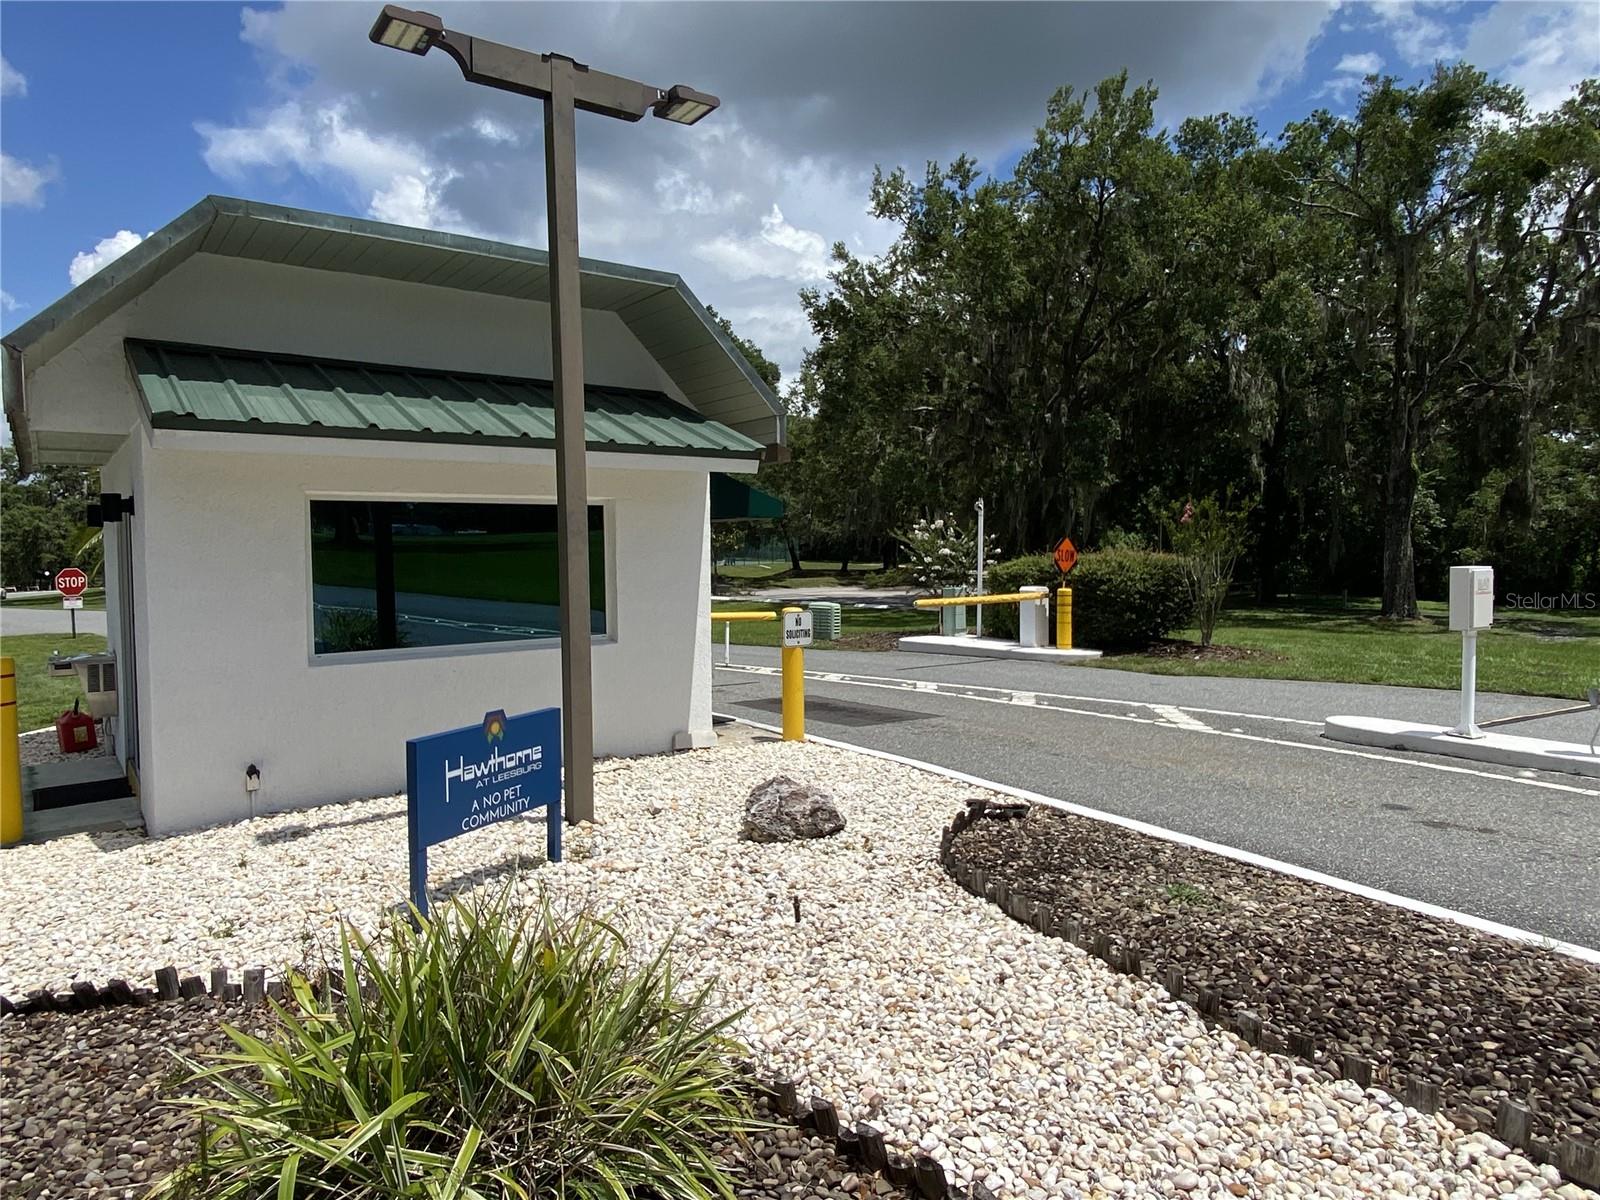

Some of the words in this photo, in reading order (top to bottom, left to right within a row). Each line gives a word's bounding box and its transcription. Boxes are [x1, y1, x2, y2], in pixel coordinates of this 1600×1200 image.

[1055, 549, 1075, 562] SLOW
[58, 576, 85, 589] STOP
[794, 616, 802, 627] NO
[785, 628, 811, 640] SOLICITING
[445, 745, 542, 803] Hawthorne
[475, 777, 490, 789] AT
[492, 761, 543, 784] LEESBURG
[471, 799, 480, 812] A
[483, 792, 501, 808] NO
[503, 784, 522, 801] PET
[461, 796, 530, 831] COMMUNITY
